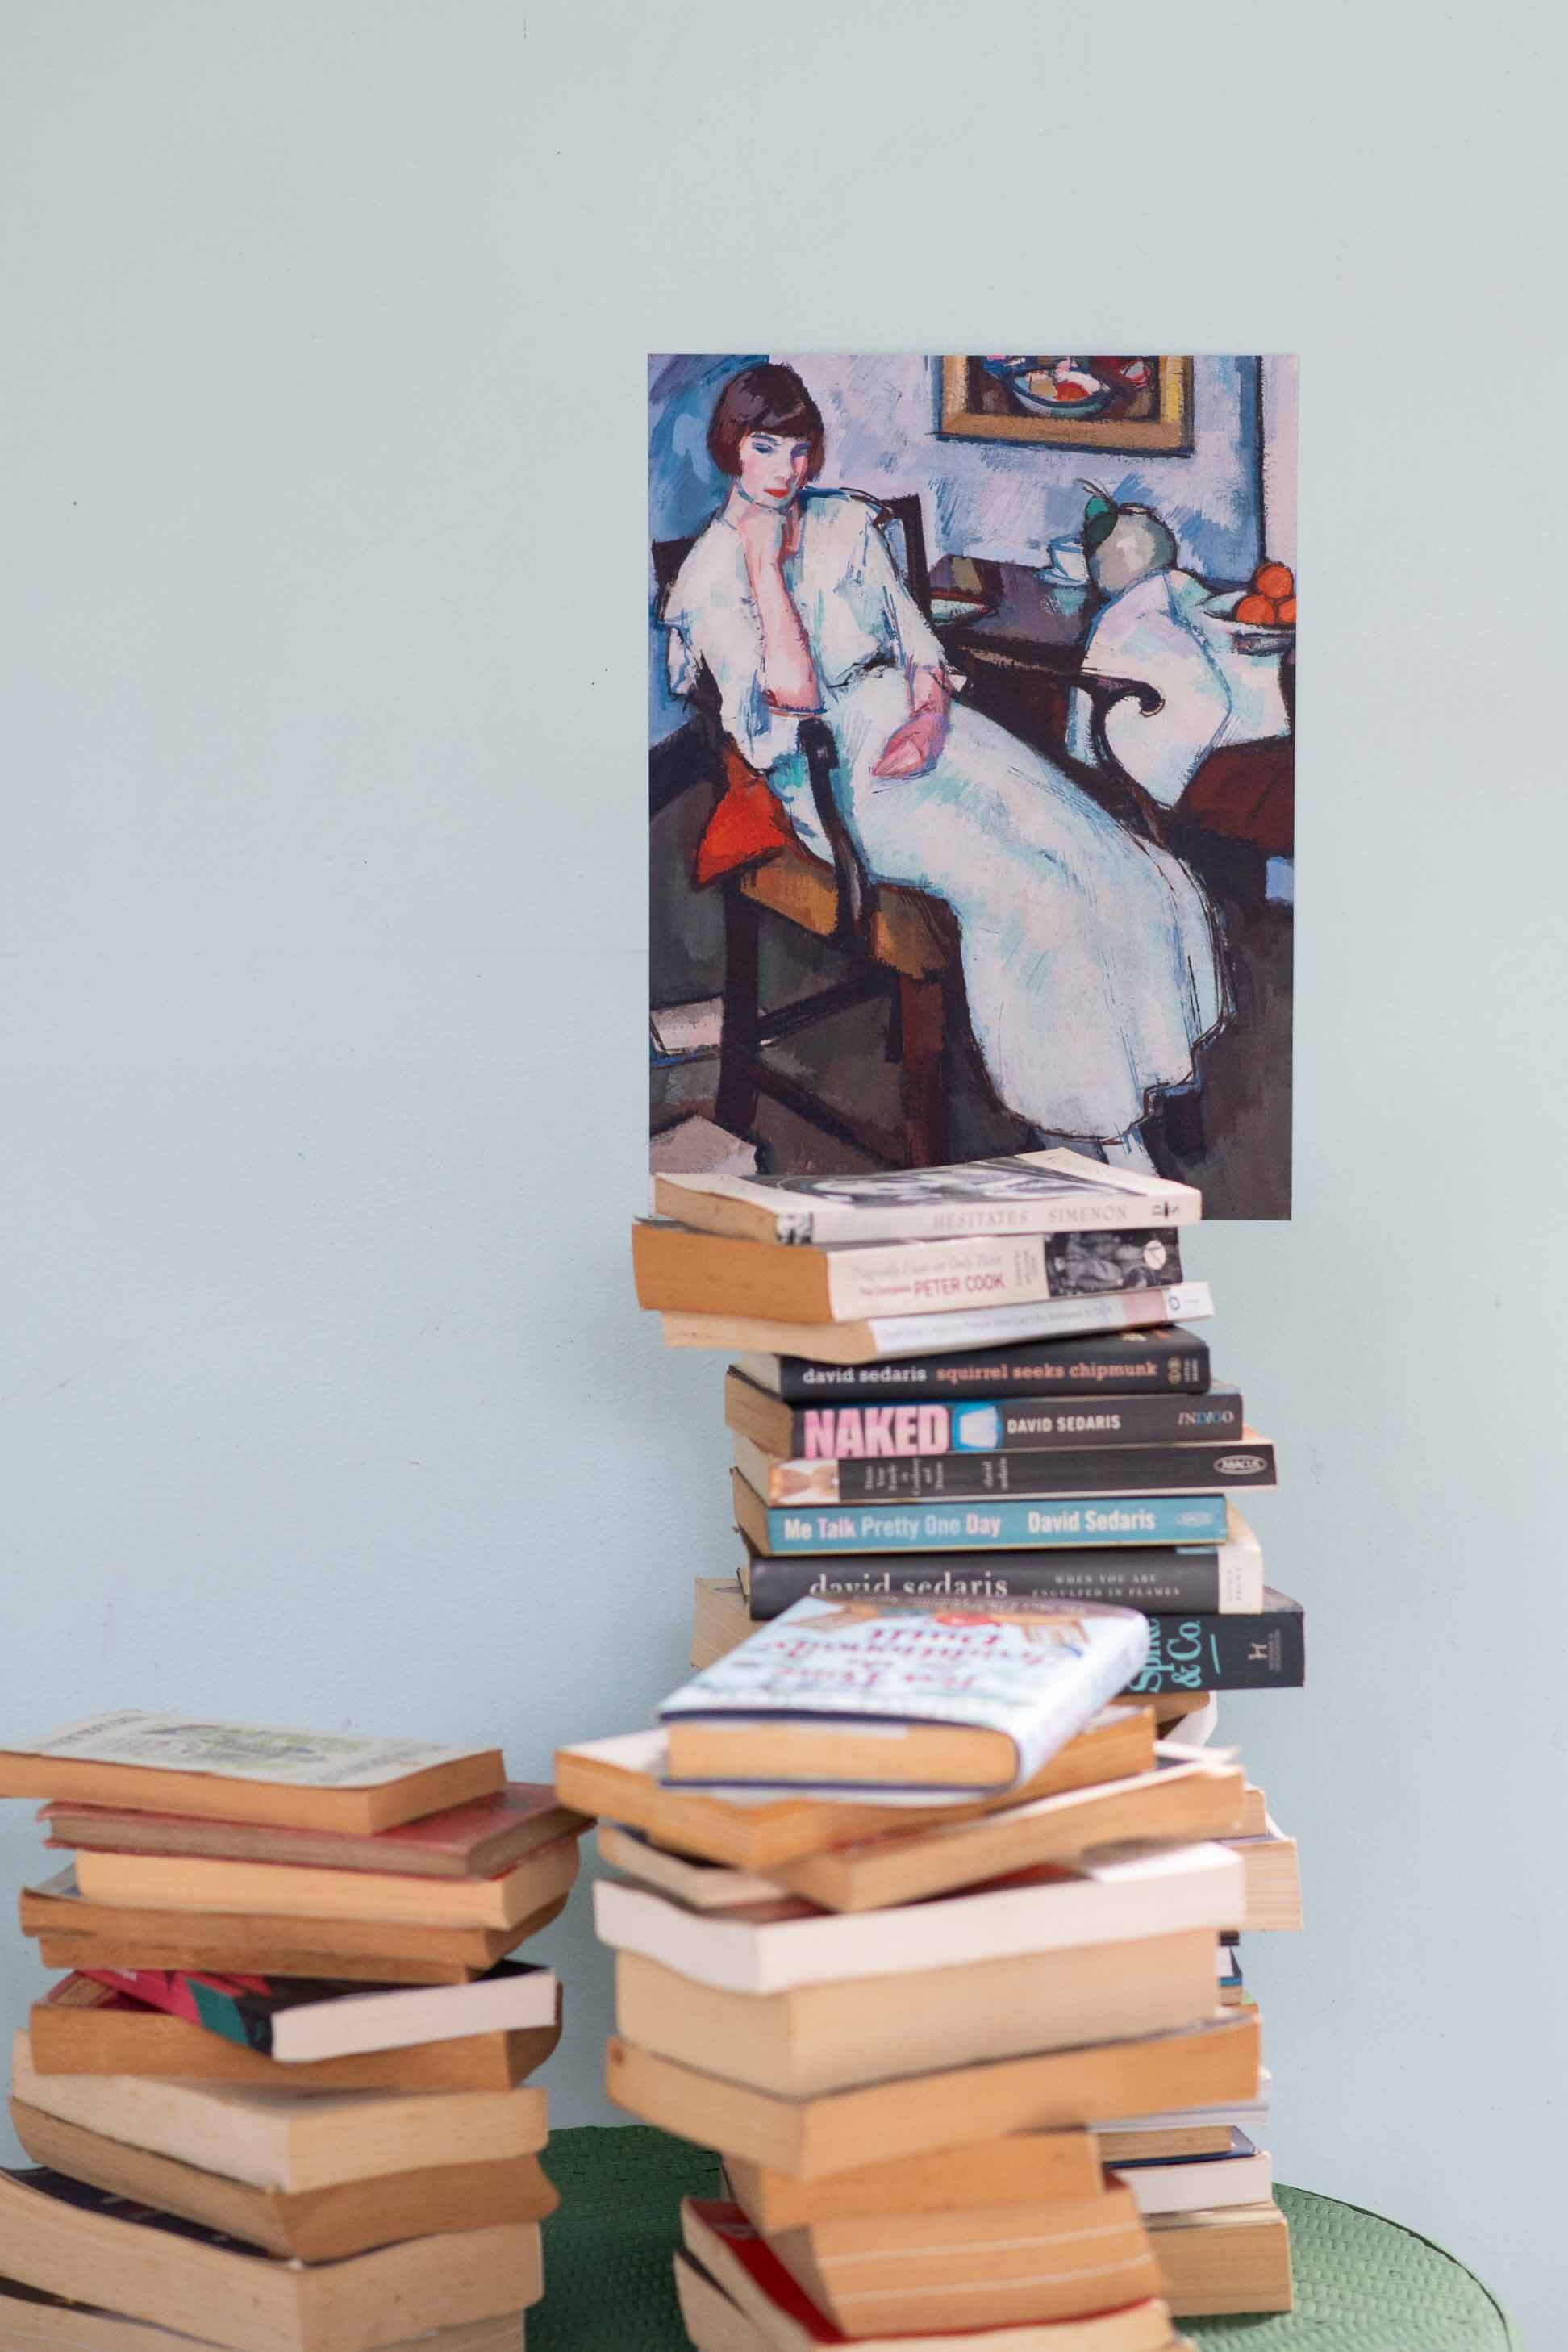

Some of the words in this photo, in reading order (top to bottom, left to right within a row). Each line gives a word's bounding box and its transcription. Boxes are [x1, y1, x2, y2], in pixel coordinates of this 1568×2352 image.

[1050, 1205, 1128, 1222] SIMENON
[914, 1277, 961, 1297] PETER
[965, 1273, 1007, 1292] COOK
[803, 1367, 855, 1384] david
[859, 1366, 927, 1383] sedaris
[936, 1363, 1007, 1385] squirrel
[1012, 1362, 1065, 1380] seeks
[1070, 1361, 1158, 1382] chipmunk
[1007, 1418, 1053, 1435] DAVID
[1057, 1414, 1121, 1432] SEDARIS
[1178, 1410, 1235, 1427] INDIGO
[804, 1404, 950, 1460] NAKED
[784, 1517, 812, 1541] Me
[816, 1516, 857, 1540] Talk
[861, 1515, 920, 1540] Pretty
[925, 1514, 961, 1537] One
[965, 1512, 1002, 1538] Day
[1027, 1510, 1080, 1533] David
[1085, 1508, 1156, 1531] Sedaris
[903, 1570, 1008, 1597] sedaris
[1170, 1664, 1202, 1688] &
